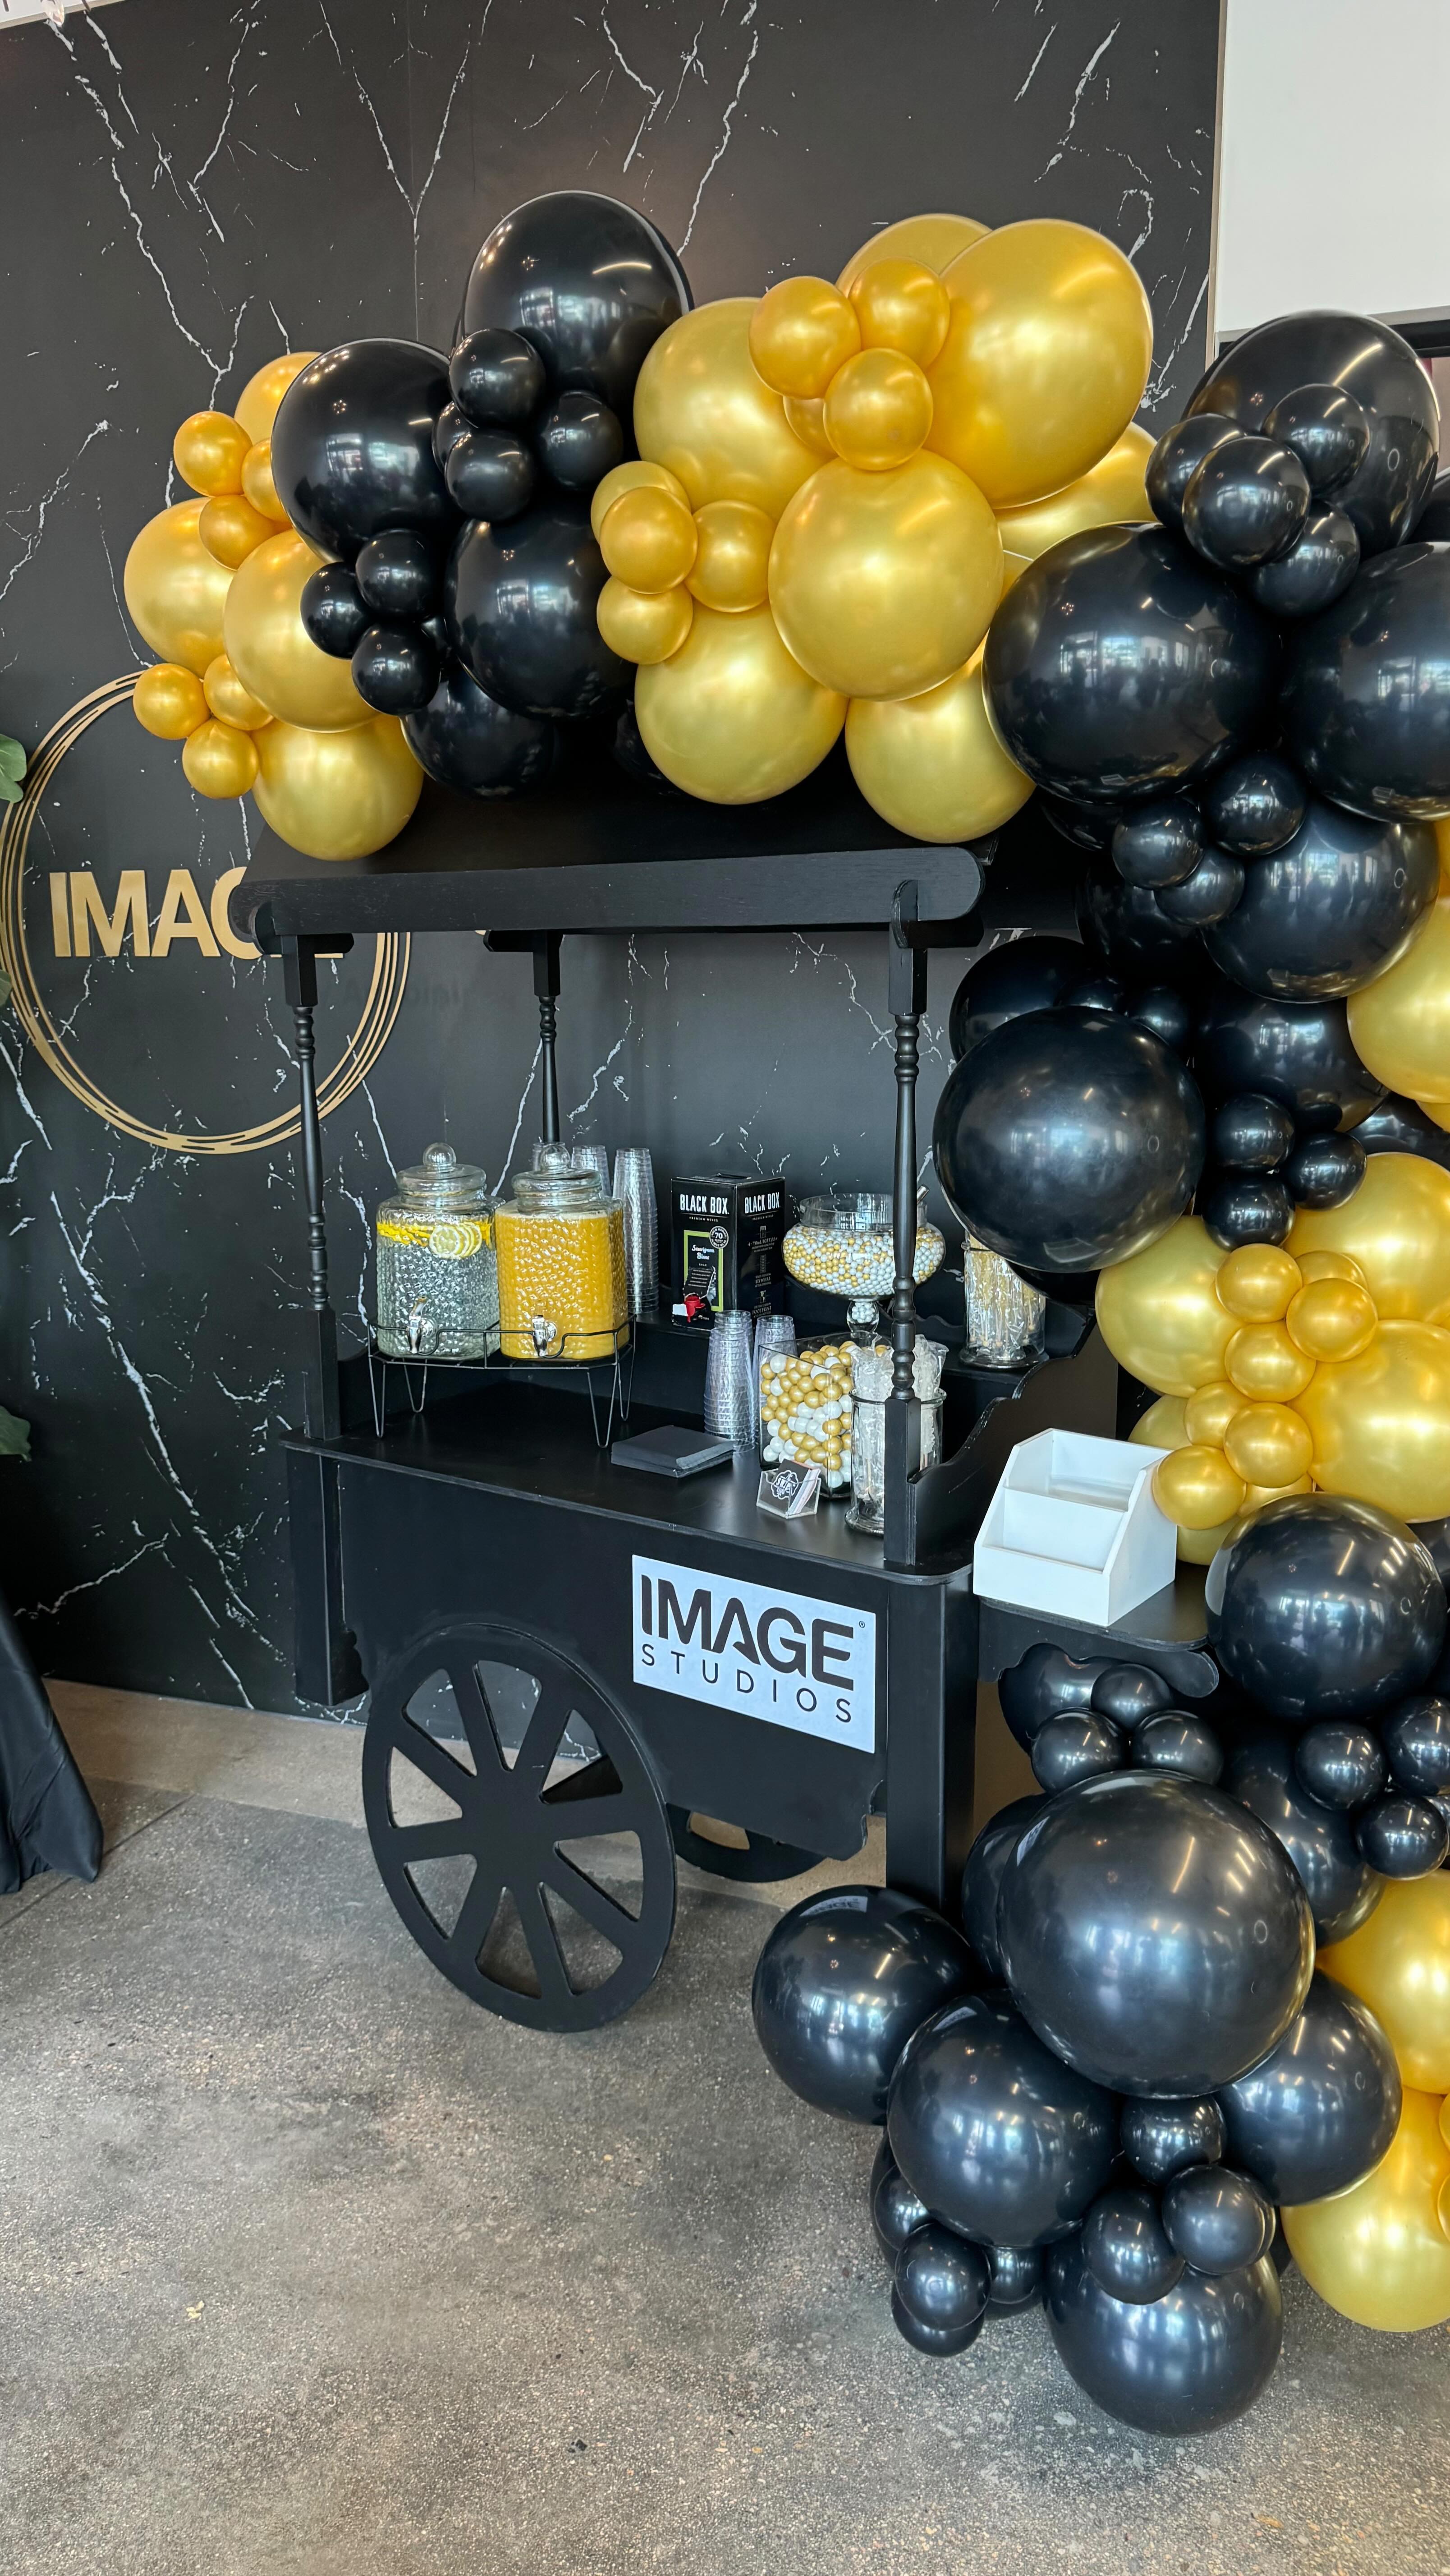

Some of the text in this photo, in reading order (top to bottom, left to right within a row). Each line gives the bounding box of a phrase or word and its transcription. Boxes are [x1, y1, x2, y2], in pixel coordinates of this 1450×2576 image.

[49, 866, 343, 959] IMA
[680, 1194, 728, 1214] BLACK BOX
[744, 1192, 780, 1214] BLACK BOX
[642, 1644, 851, 1723] STUDIOS
